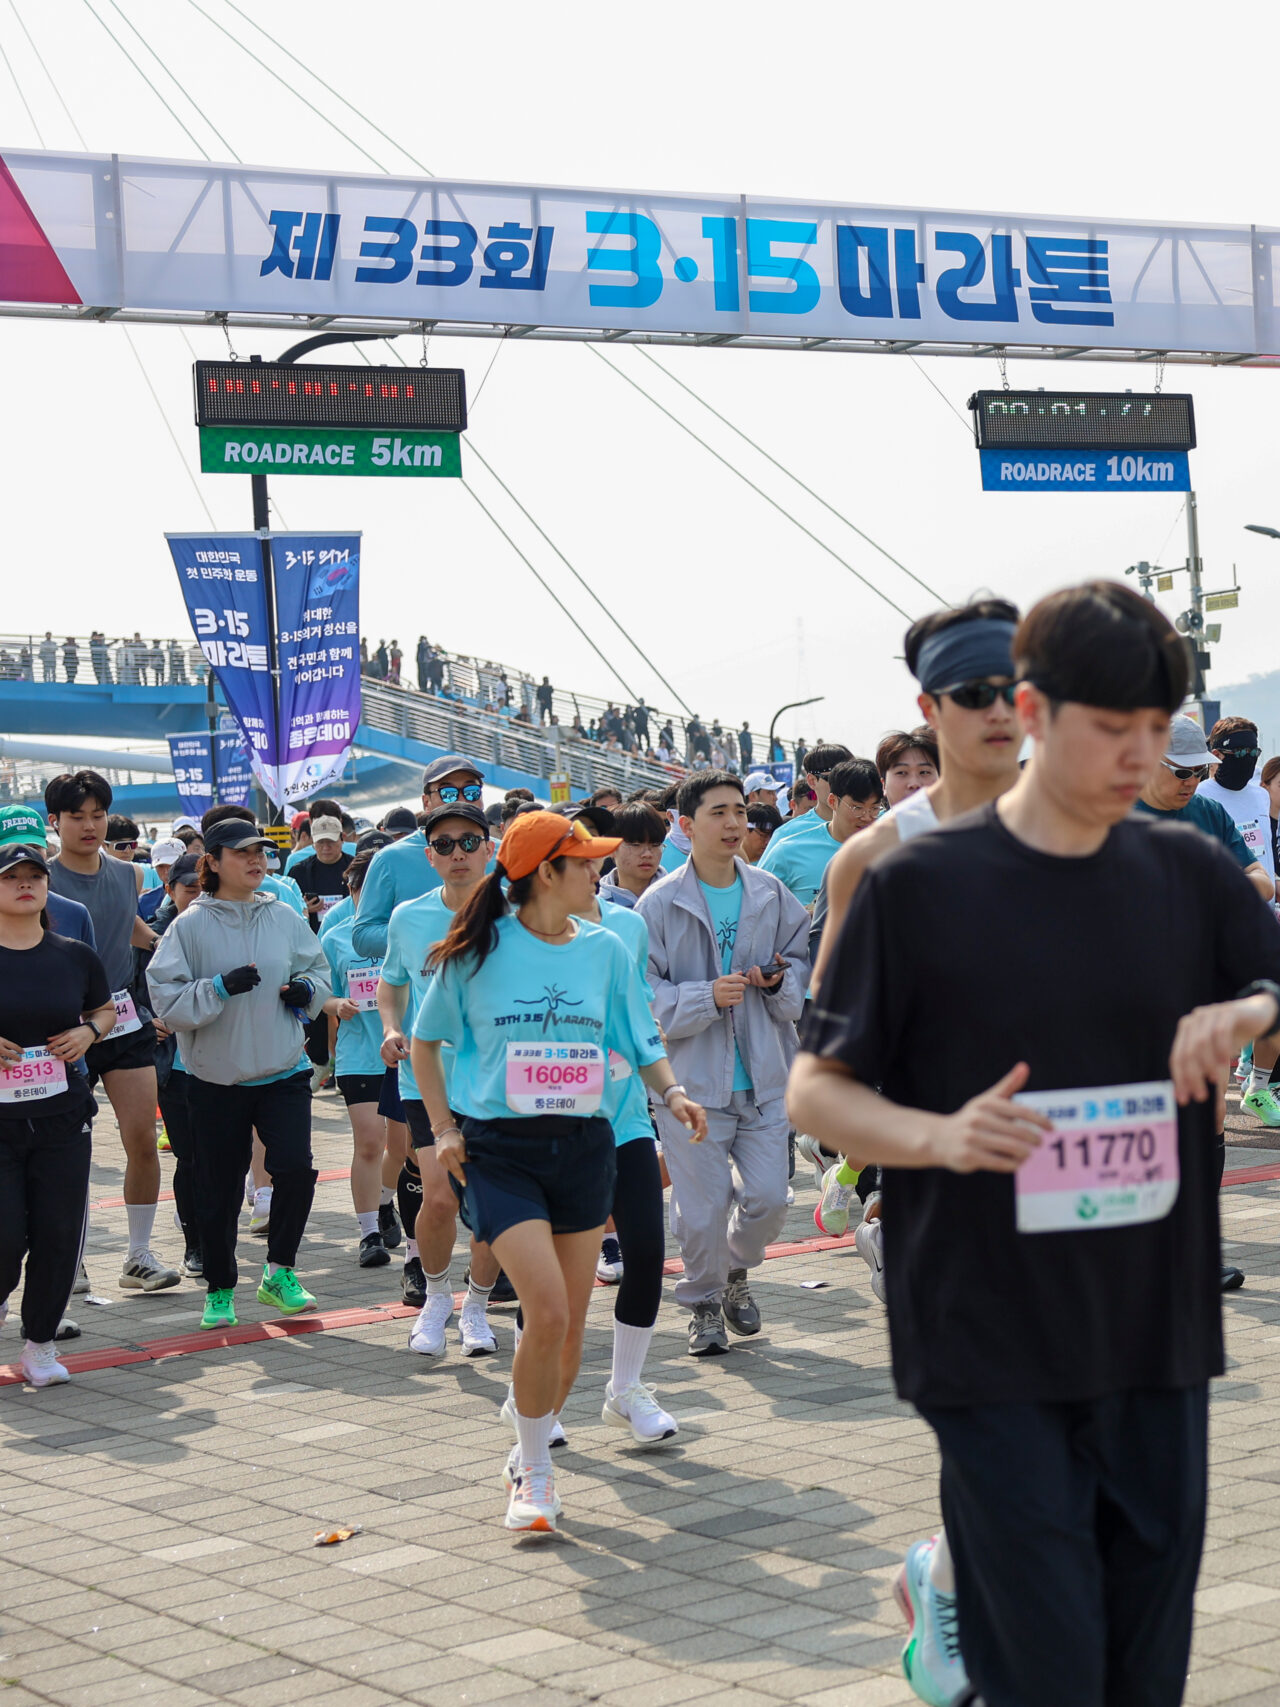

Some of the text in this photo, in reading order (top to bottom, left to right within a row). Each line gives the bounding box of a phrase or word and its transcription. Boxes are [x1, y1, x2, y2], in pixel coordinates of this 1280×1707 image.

[259, 209, 341, 281] 제
[354, 216, 555, 291] 33회
[836, 224, 1114, 327] 마라톤
[224, 437, 442, 466] ROADRACE 5km
[1001, 456, 1174, 481] ROADRACE 10km
[196, 551, 240, 564] 대한민국
[319, 548, 350, 565] 의거
[186, 567, 258, 582] 첫 민주화 운동
[200, 640, 268, 671] 마라톤
[329, 646, 353, 661] 함께
[289, 721, 351, 749] 좋은데이
[2, 816, 39, 831] FREEDOM
[494, 1013, 521, 1027] 33TH
[35, 1049, 52, 1058] 마라
[522, 1049, 541, 1057] 33회
[569, 1049, 599, 1059] 마라톤
[3, 1061, 54, 1081] 15513
[524, 1065, 588, 1084] 16068
[14, 1086, 47, 1098] 좋은데이
[535, 1098, 576, 1109] 좋은데이
[1050, 1128, 1156, 1169] 11770
